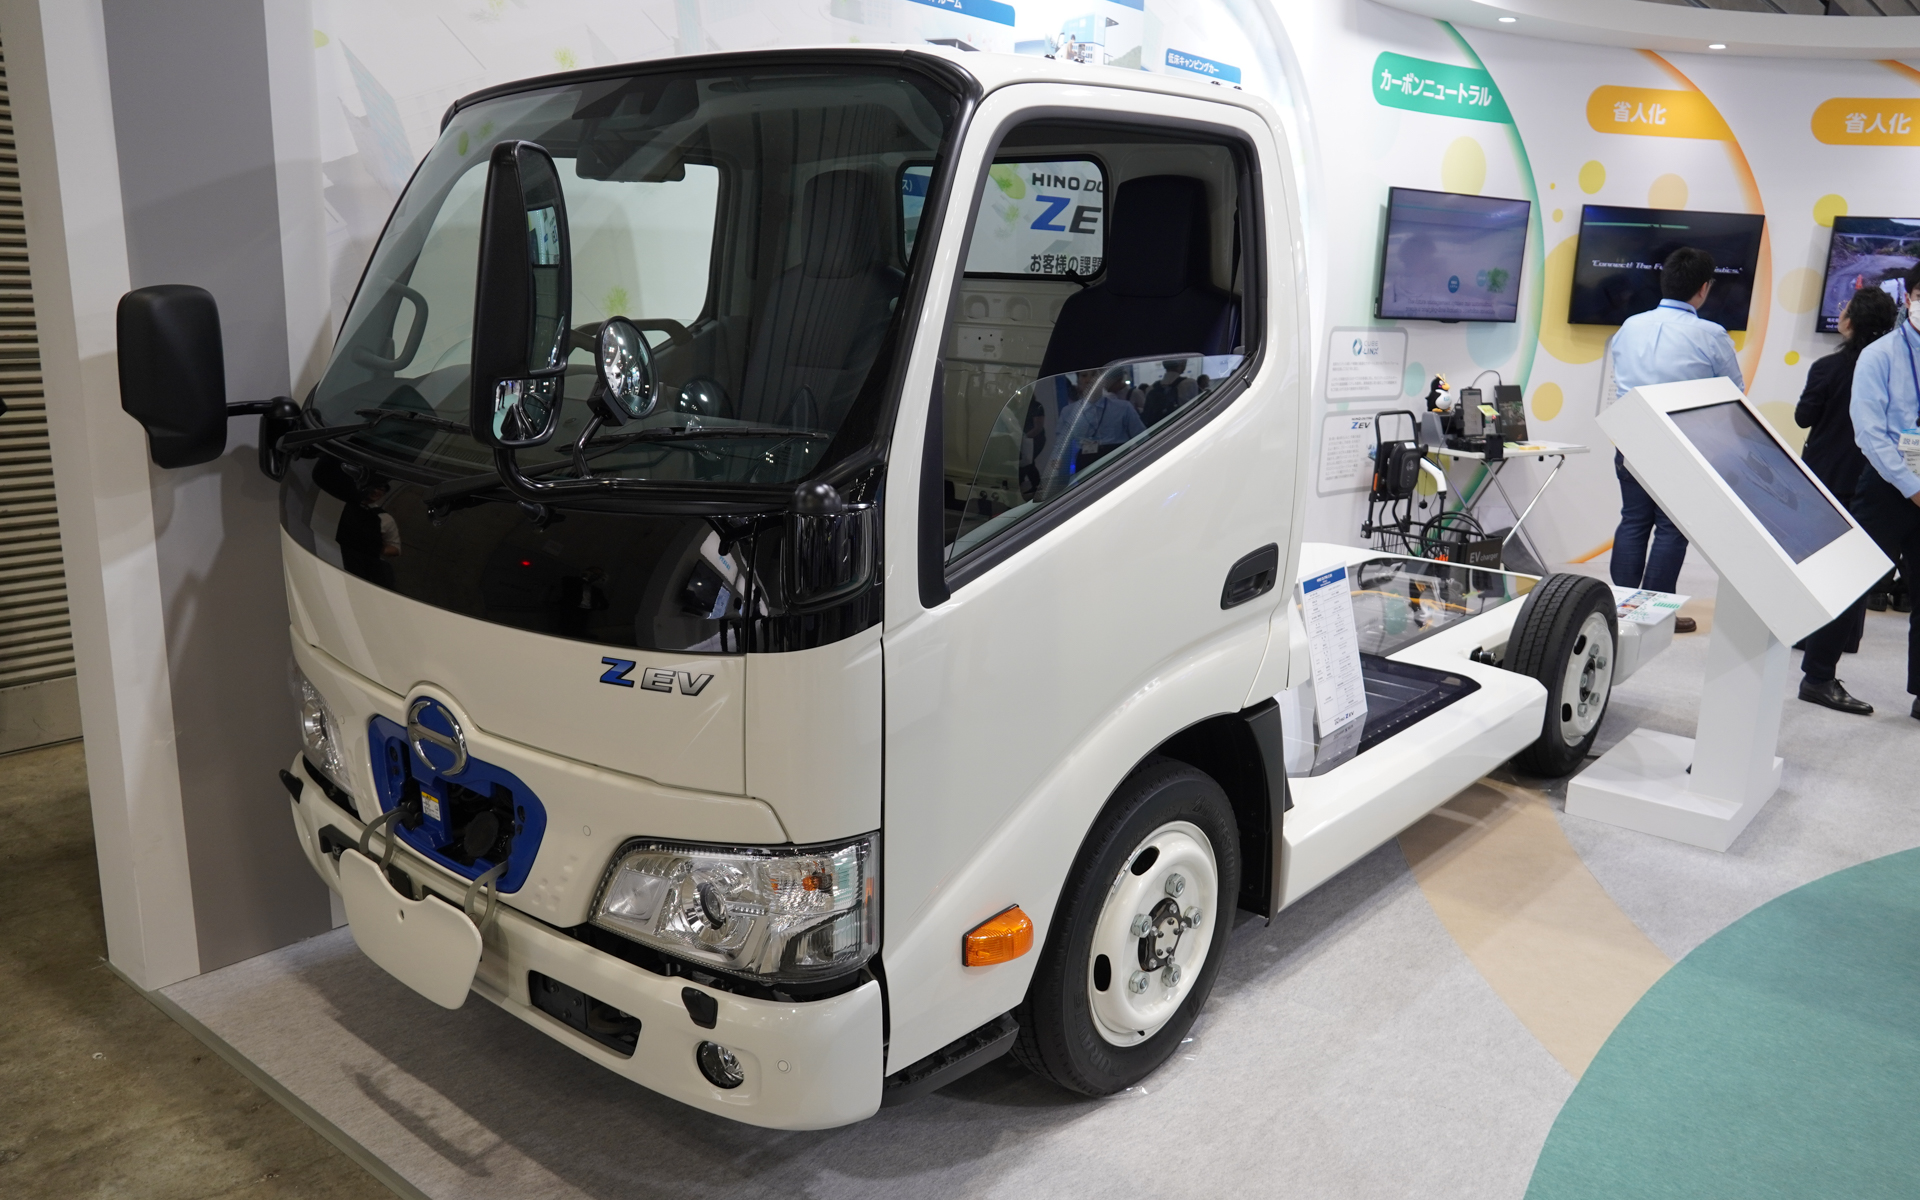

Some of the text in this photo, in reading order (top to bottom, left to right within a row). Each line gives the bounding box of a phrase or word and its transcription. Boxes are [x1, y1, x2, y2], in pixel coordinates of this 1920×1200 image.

[1168, 52, 1220, 74] 低床キャンピングカー
[1380, 68, 1493, 107] カーボンニュートラル
[1613, 101, 1667, 125] 省人化
[1845, 112, 1912, 134] 省人化
[1032, 172, 1080, 191] HINO
[1636, 261, 1652, 270] The
[1351, 421, 1371, 430] ZEV
[1470, 551, 1481, 564] EV
[599, 656, 715, 697] ZEV
